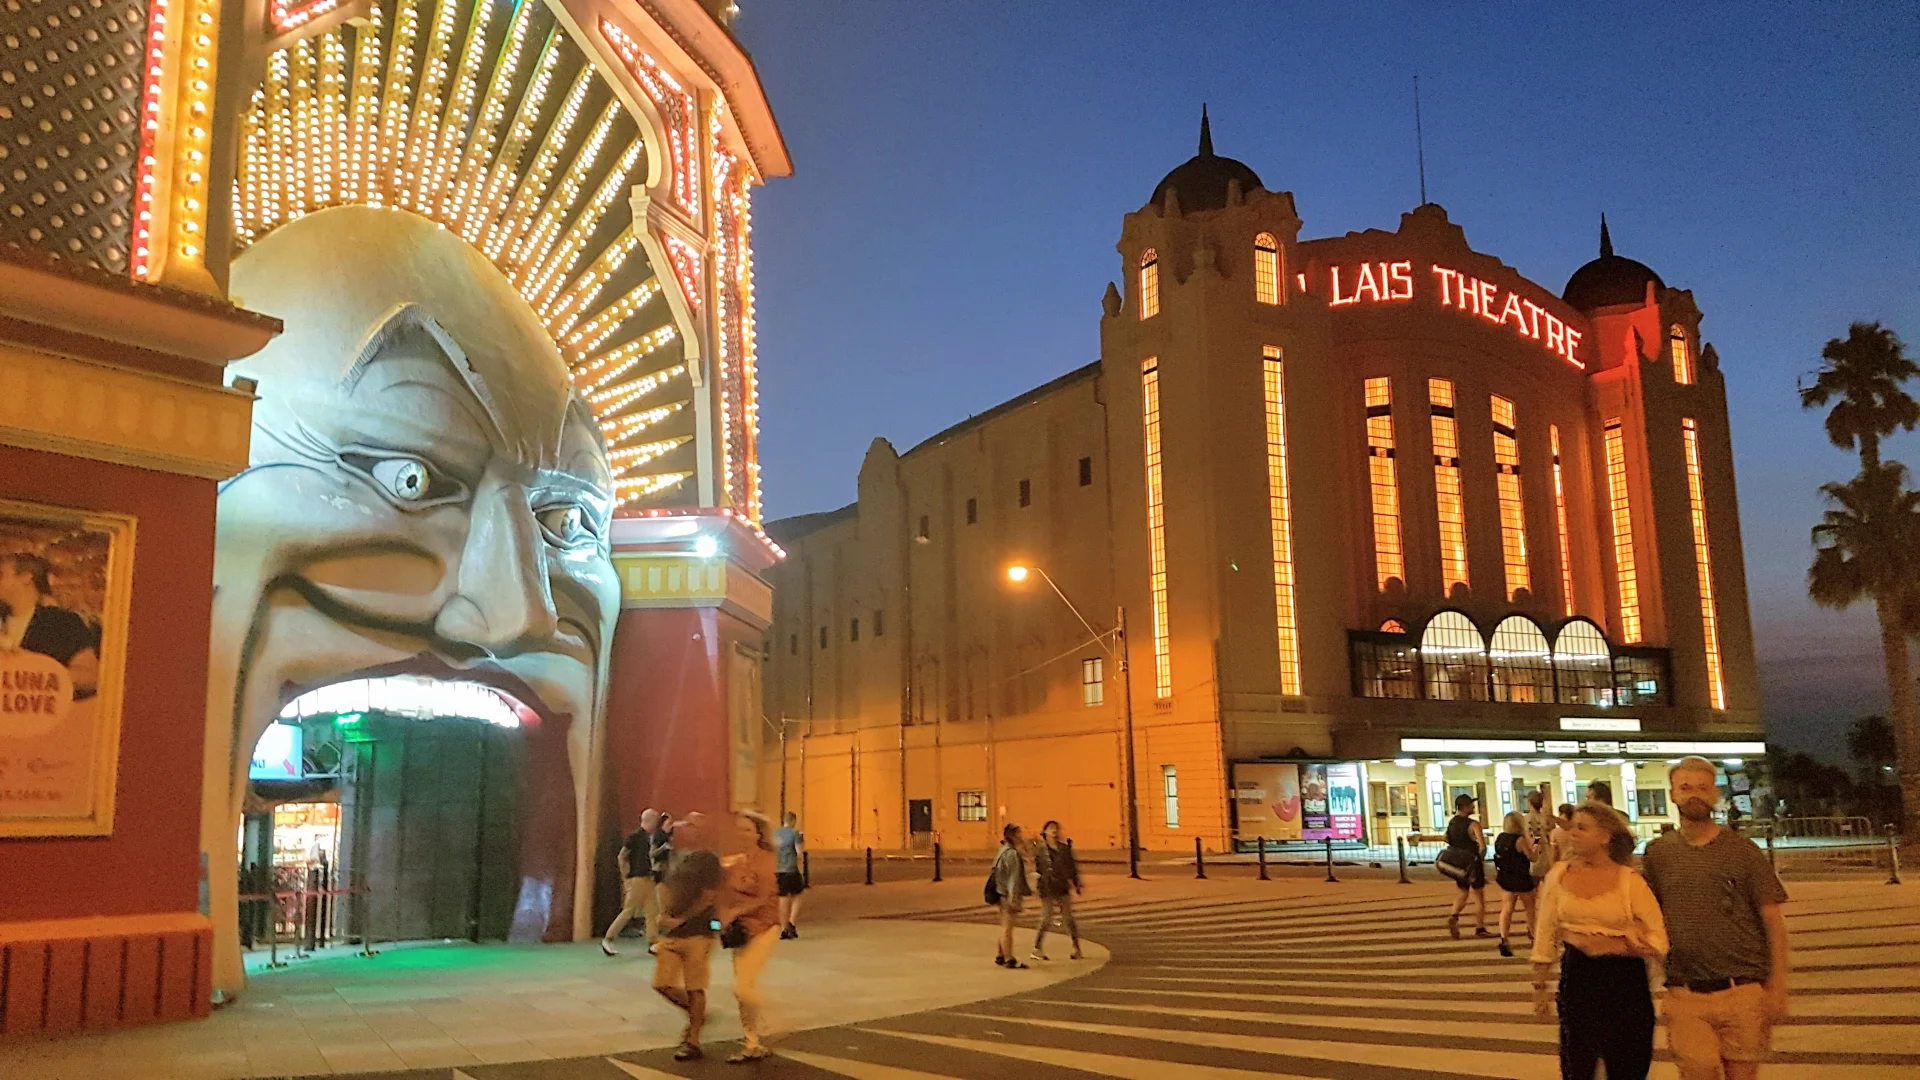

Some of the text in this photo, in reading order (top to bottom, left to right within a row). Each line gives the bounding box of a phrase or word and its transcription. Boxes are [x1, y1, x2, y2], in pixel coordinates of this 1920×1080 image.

[1432, 264, 1585, 370] THEATRE
[2, 670, 60, 692] LUNA
[2, 693, 57, 714] LOVE
